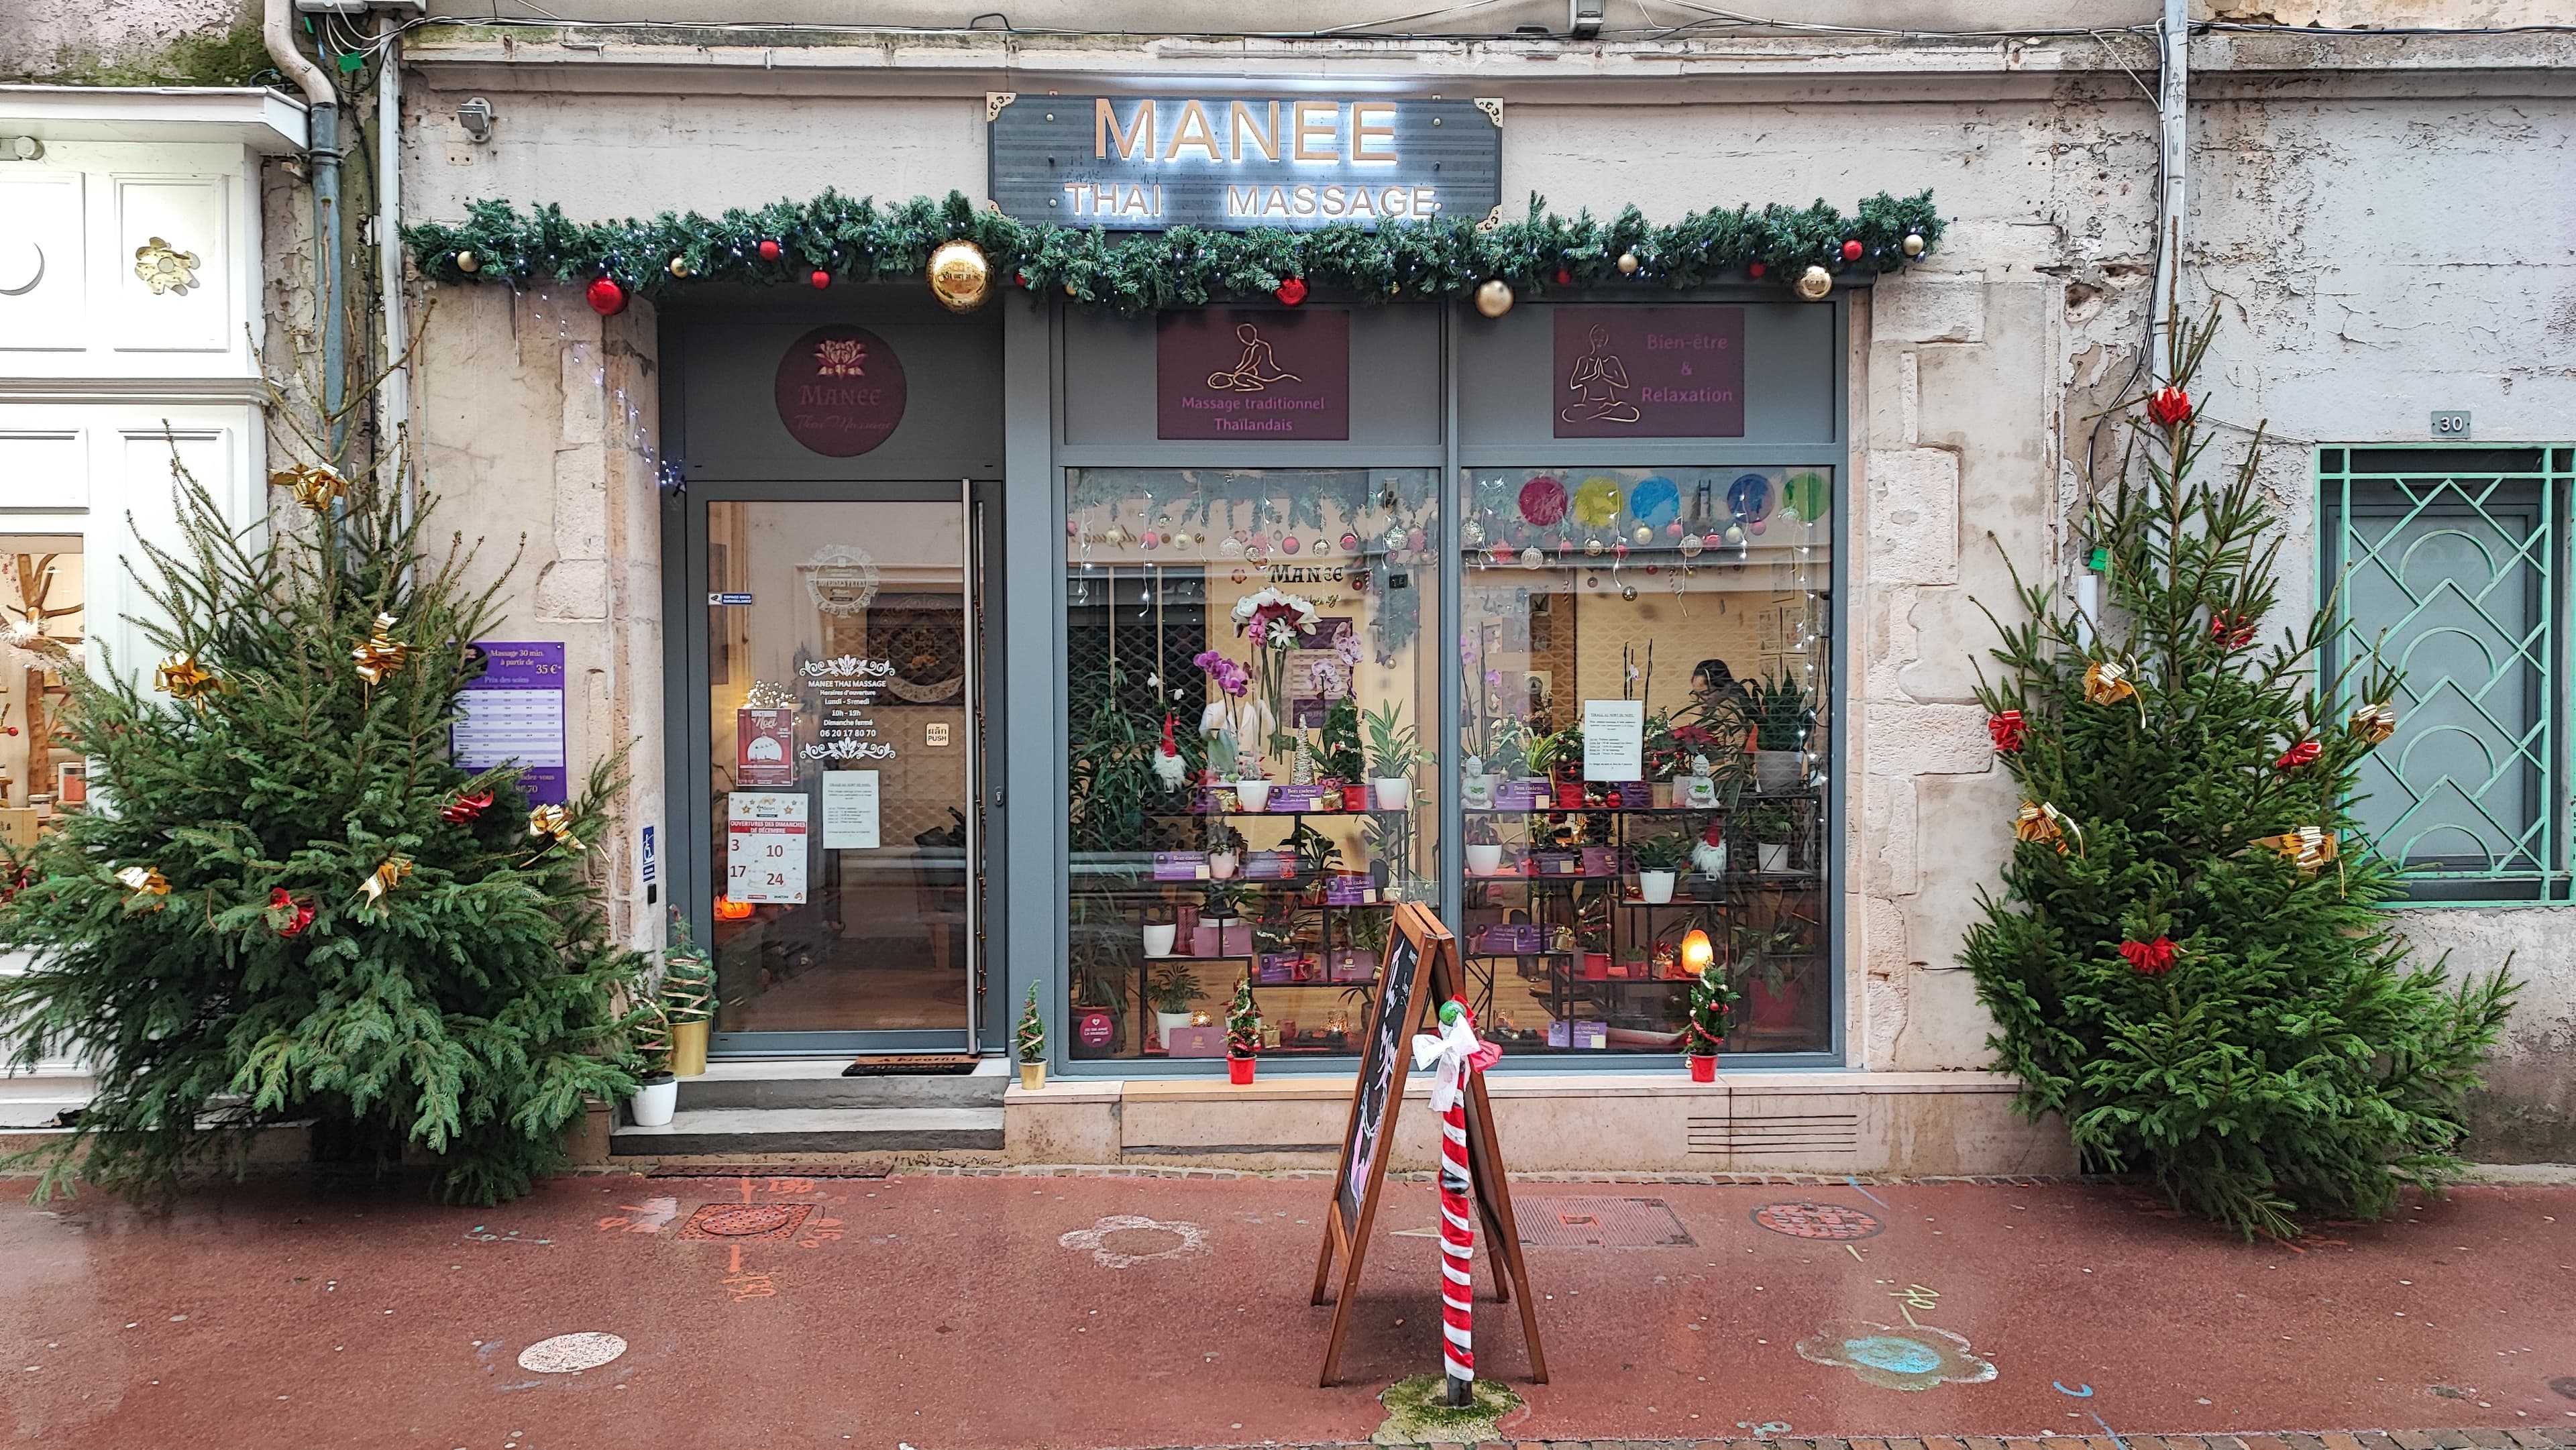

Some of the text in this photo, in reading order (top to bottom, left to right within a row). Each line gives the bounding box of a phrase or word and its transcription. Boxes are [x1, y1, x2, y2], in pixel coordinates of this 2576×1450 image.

[1095, 98, 1398, 162] MANEE
[1064, 183, 1436, 218] THAI MASSAGE
[1647, 334, 1728, 349] Bien-être
[1680, 362, 1693, 376] &
[1642, 387, 1733, 402] Relaxation
[1182, 397, 1324, 413] Massage traditionnel
[1215, 419, 1293, 431] Thaïlandais
[2440, 416, 2463, 431] 30
[490, 649, 518, 658] Massage
[506, 659, 525, 667] partir
[536, 664, 548, 674] 35
[820, 729, 876, 737] 06 20 17 80 70
[527, 785, 538, 793] 70
[731, 839, 739, 851] 3
[766, 845, 784, 857] 10
[730, 865, 747, 877] 17
[767, 873, 784, 885] 24
